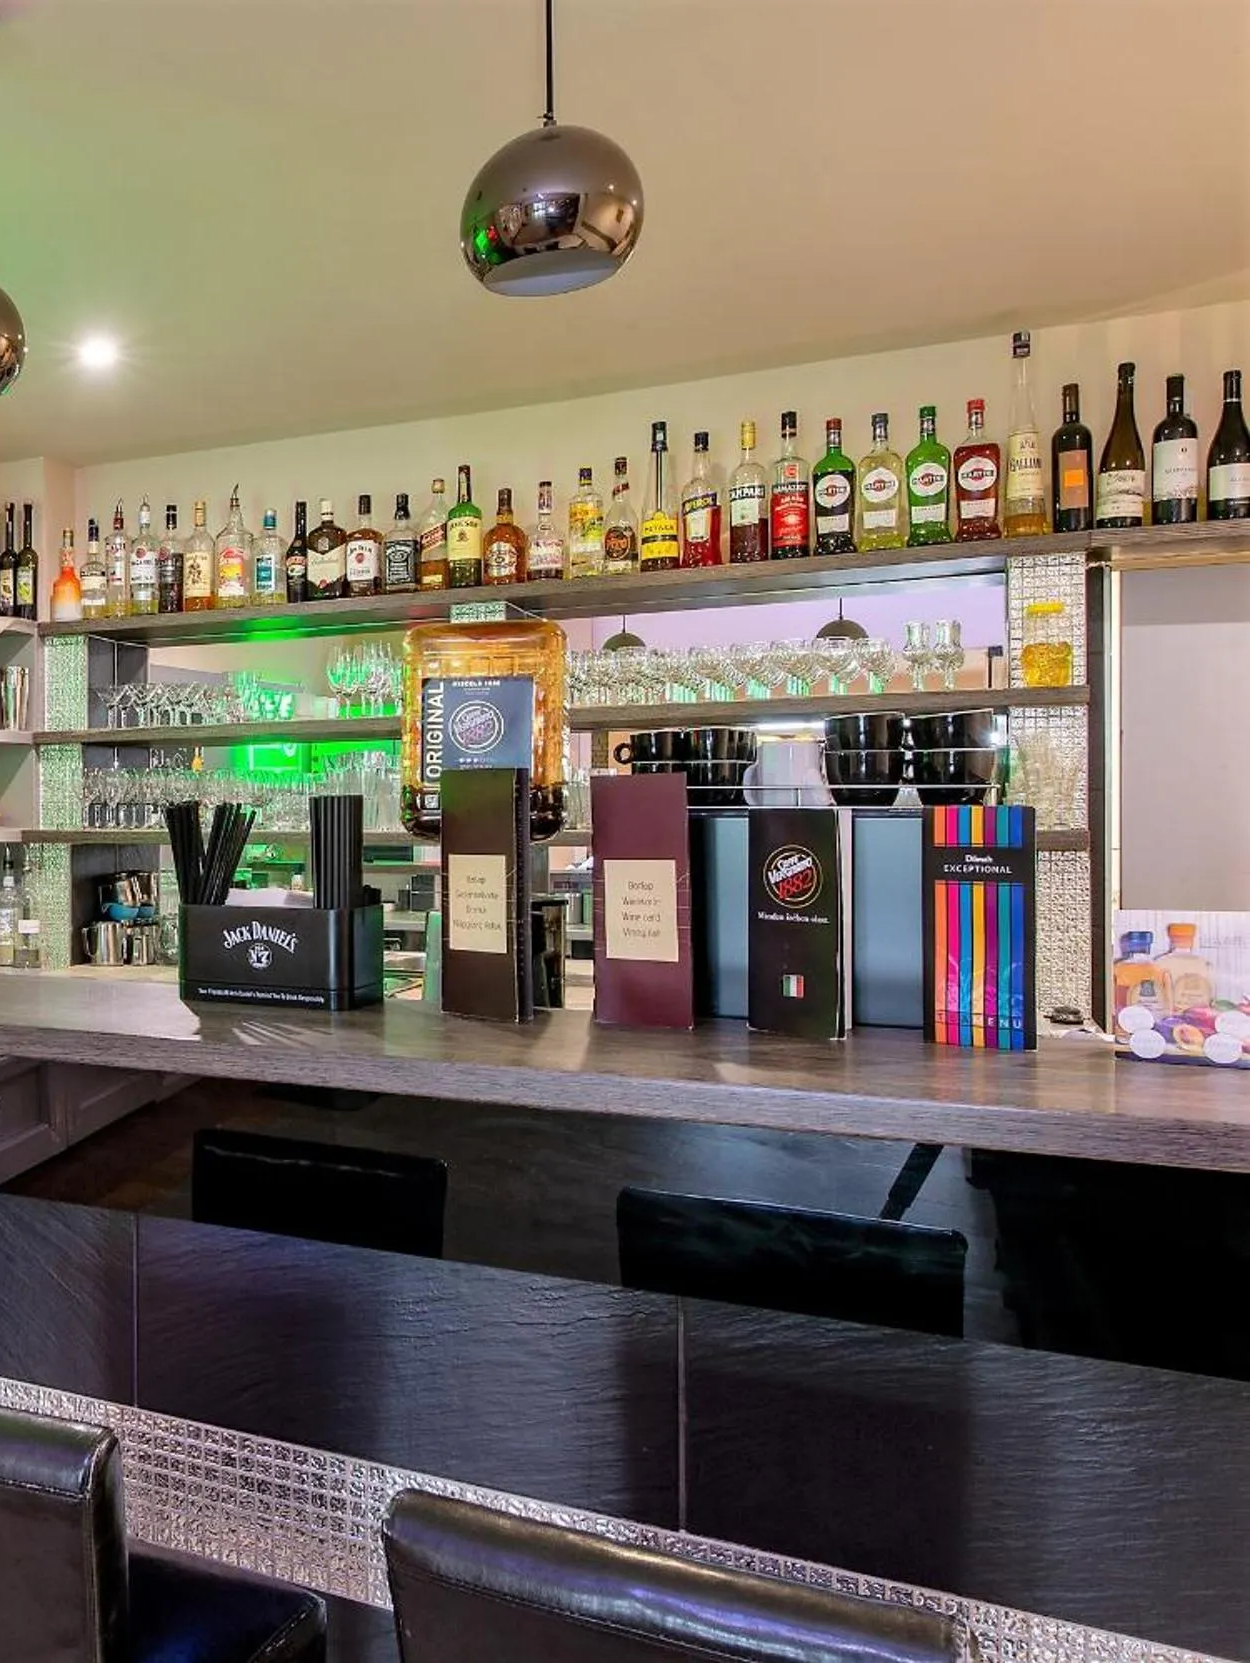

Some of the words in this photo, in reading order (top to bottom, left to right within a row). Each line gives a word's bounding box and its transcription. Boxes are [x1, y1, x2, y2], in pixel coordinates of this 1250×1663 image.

[425, 681, 445, 779] ORIGINAL
[779, 868, 812, 899] 1882
[943, 864, 1013, 874] EXCEPTIONAL
[222, 924, 252, 949] JACK
[252, 920, 298, 954] DANIEL'S
